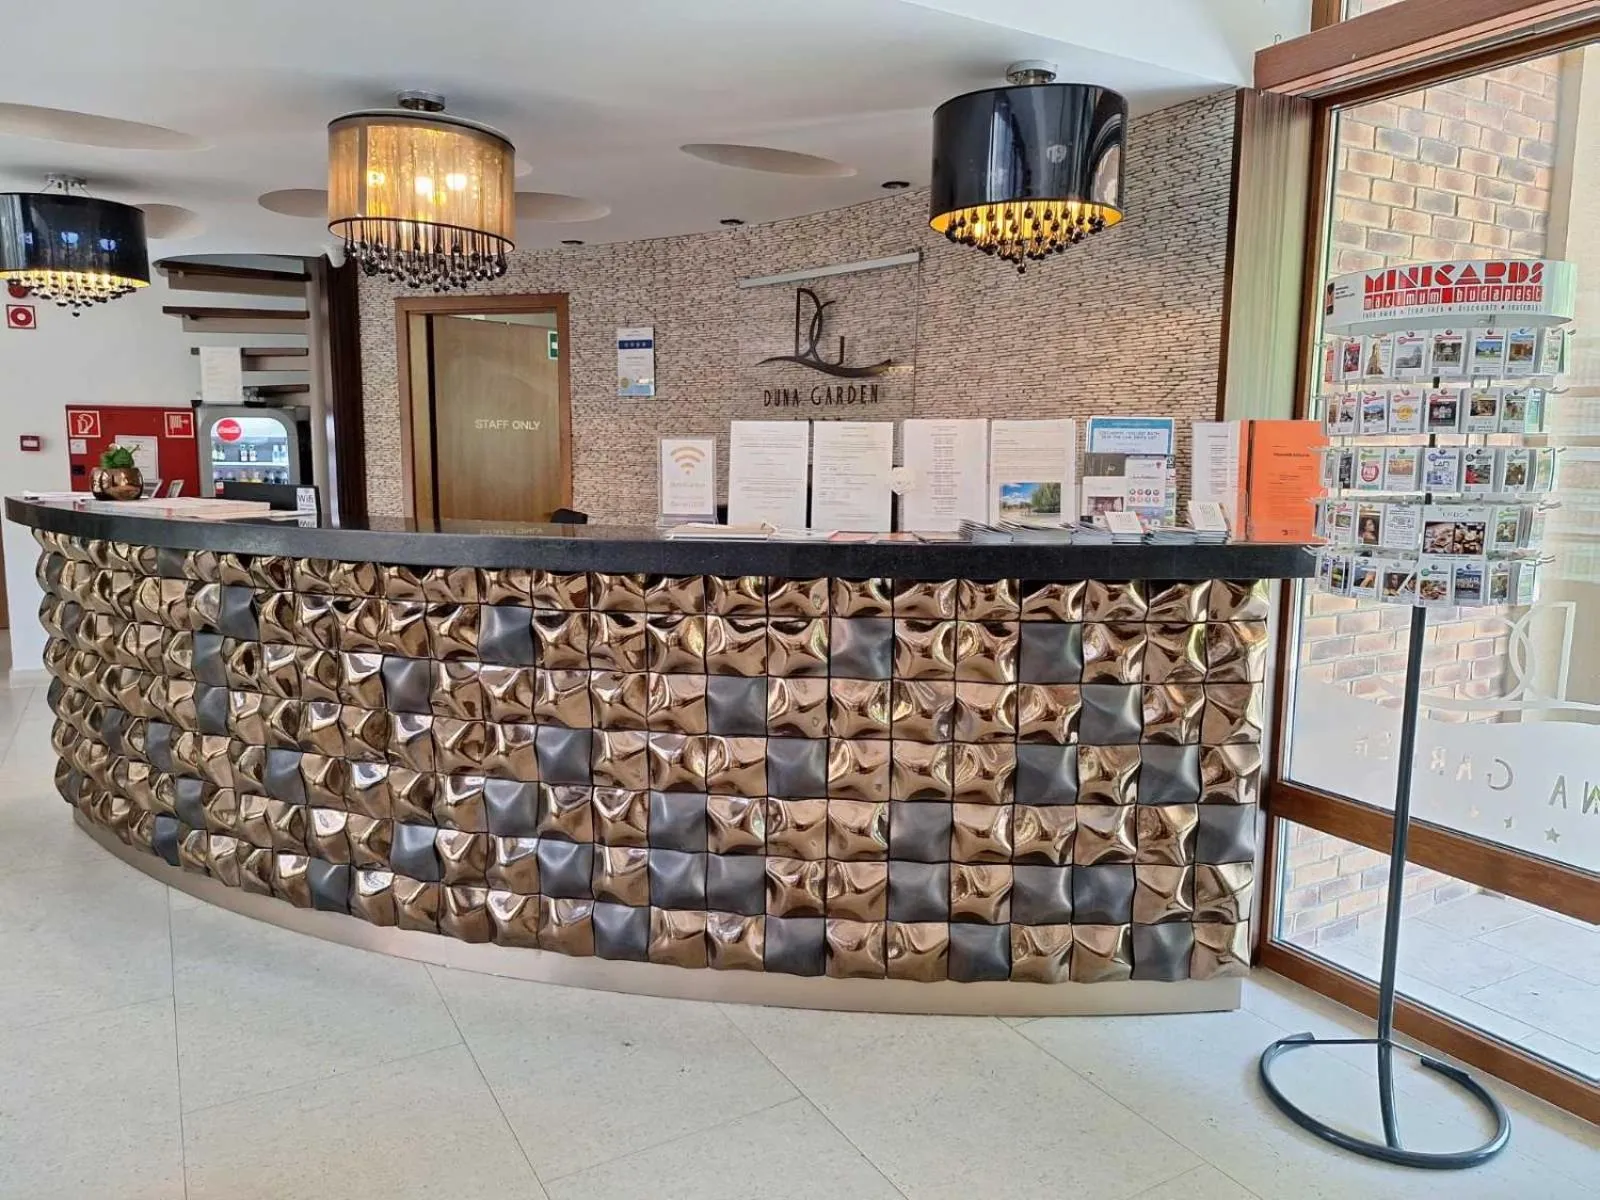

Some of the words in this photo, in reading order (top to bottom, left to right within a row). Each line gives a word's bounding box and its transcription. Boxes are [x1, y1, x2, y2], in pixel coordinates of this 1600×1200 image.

[1364, 261, 1544, 293] MINICARDS
[1363, 287, 1441, 310] maximum
[1454, 285, 1542, 302] budapest
[764, 389, 799, 406] DUNA
[811, 384, 879, 406] GARDEN
[475, 419, 509, 430] STAFF
[512, 420, 541, 430] ONLY
